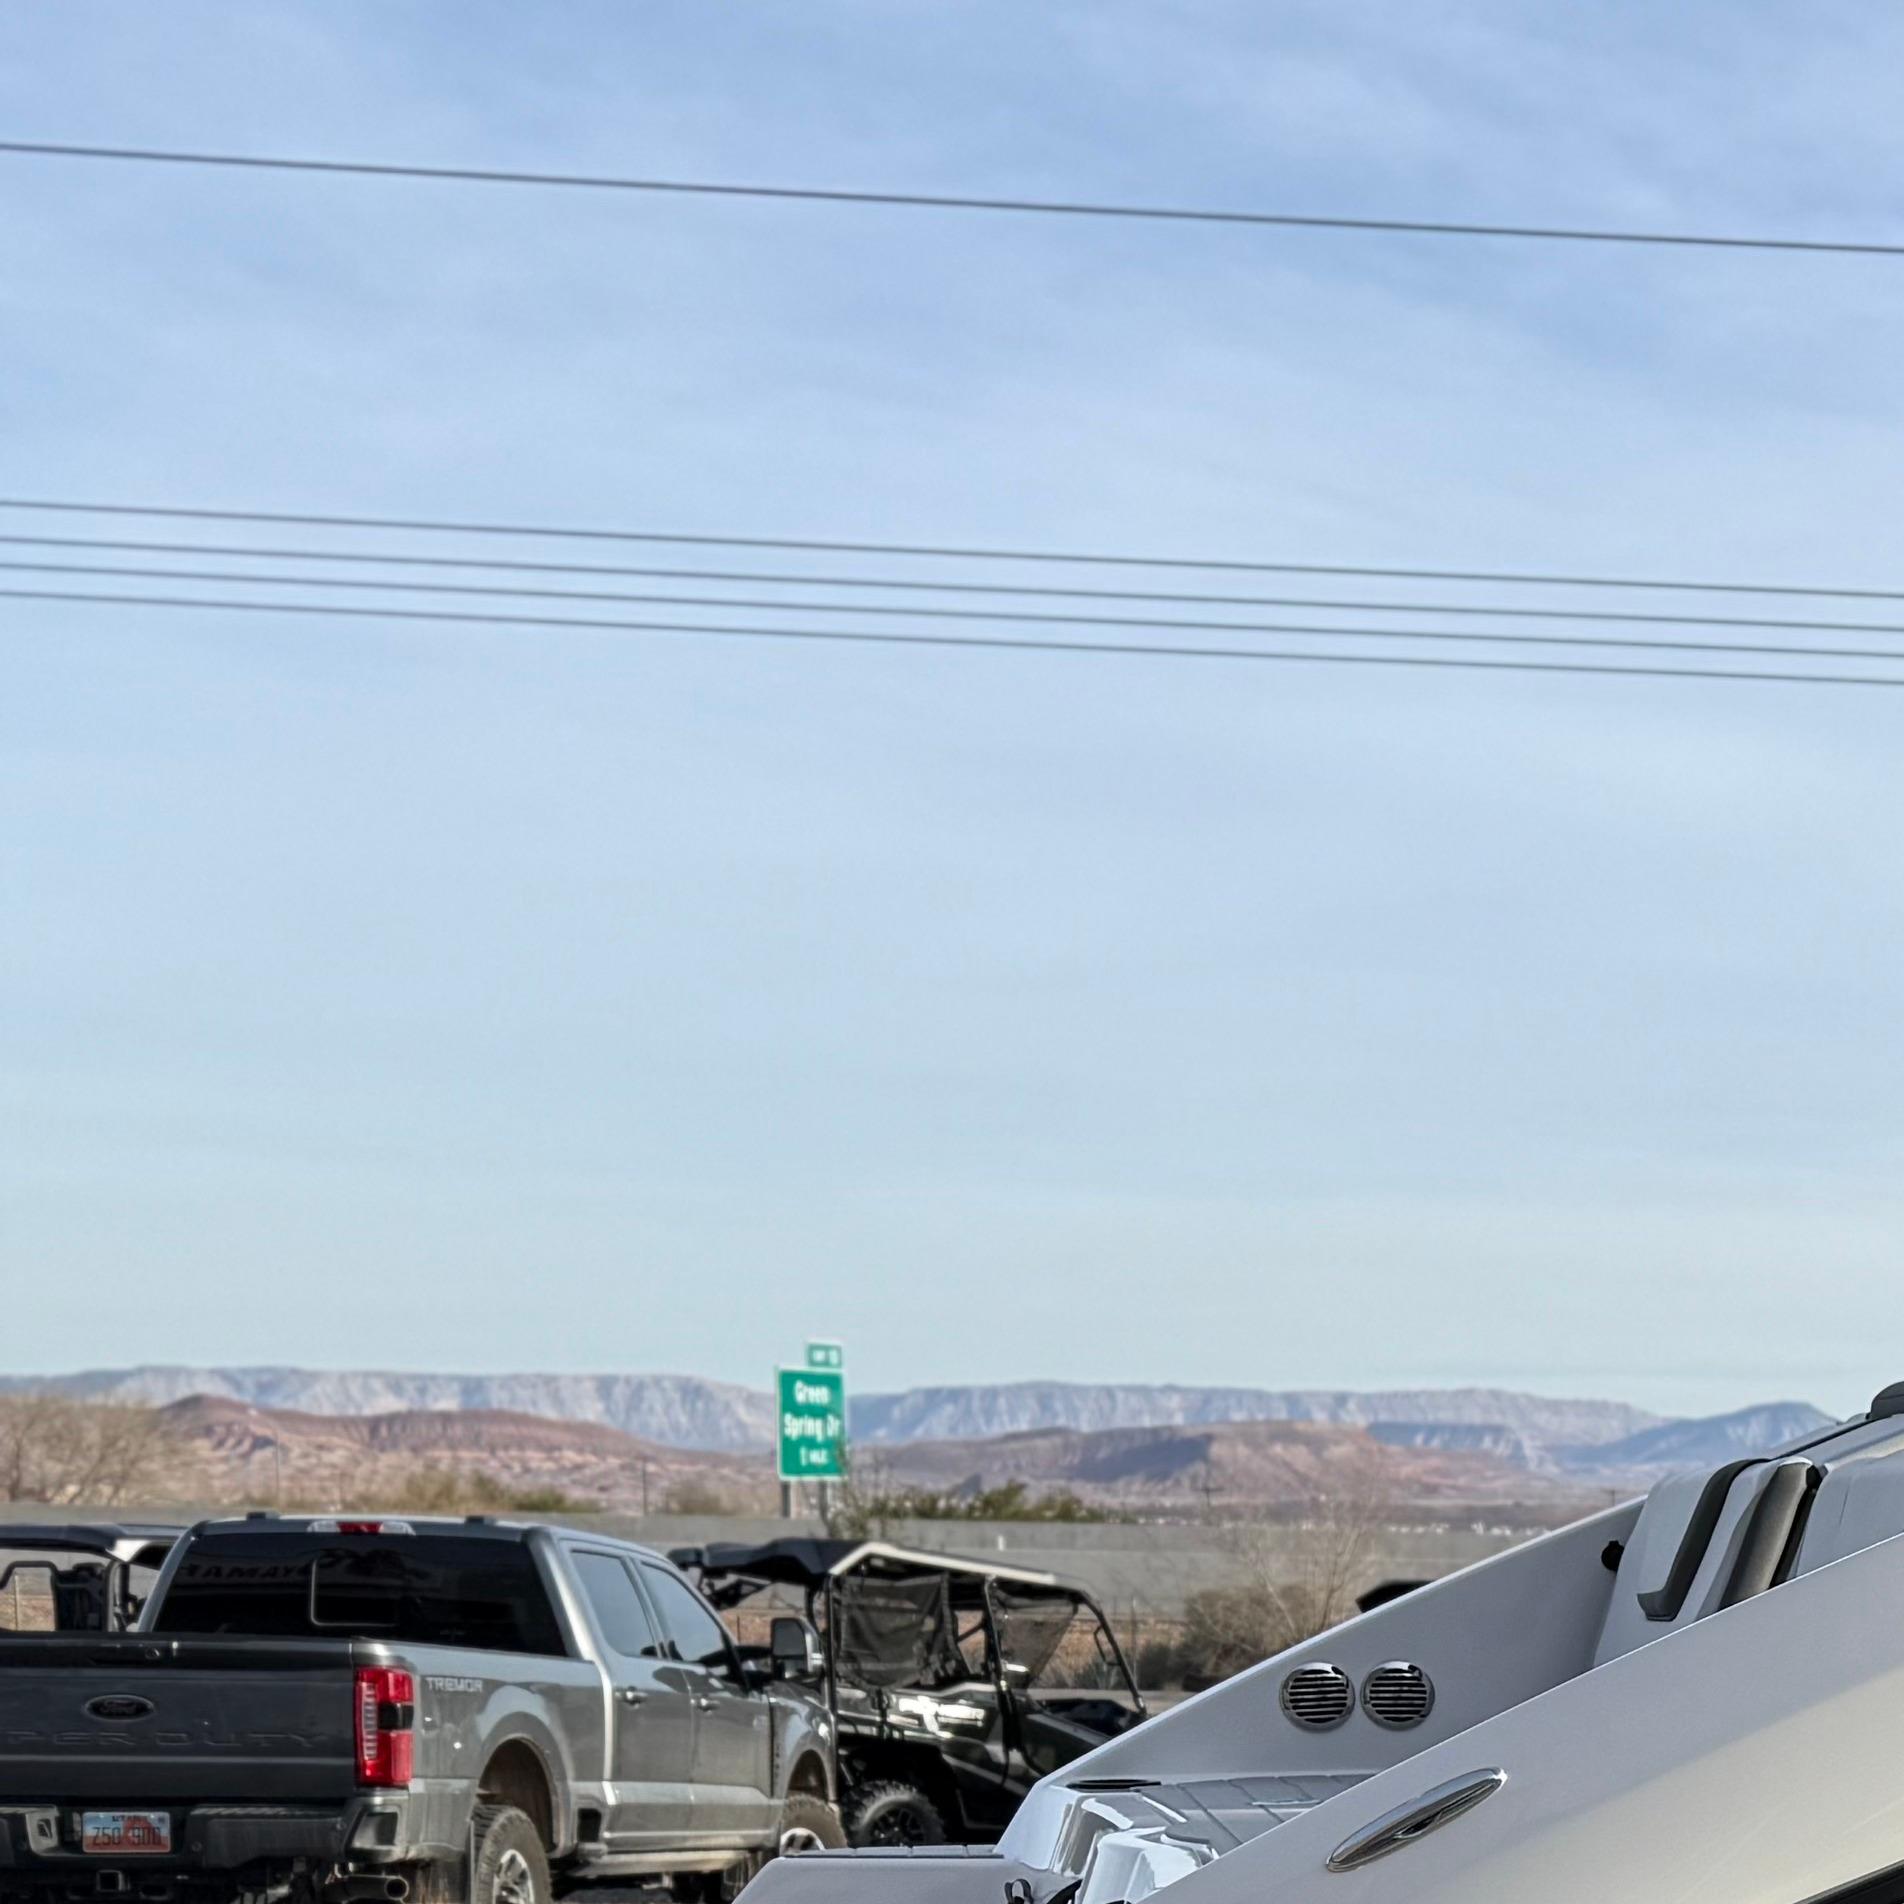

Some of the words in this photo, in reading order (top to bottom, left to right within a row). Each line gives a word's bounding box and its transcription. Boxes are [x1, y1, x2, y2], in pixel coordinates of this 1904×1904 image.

[794, 1380, 831, 1404] Green
[784, 1413, 825, 1442] Spring
[425, 1677, 483, 1693] TREMOR
